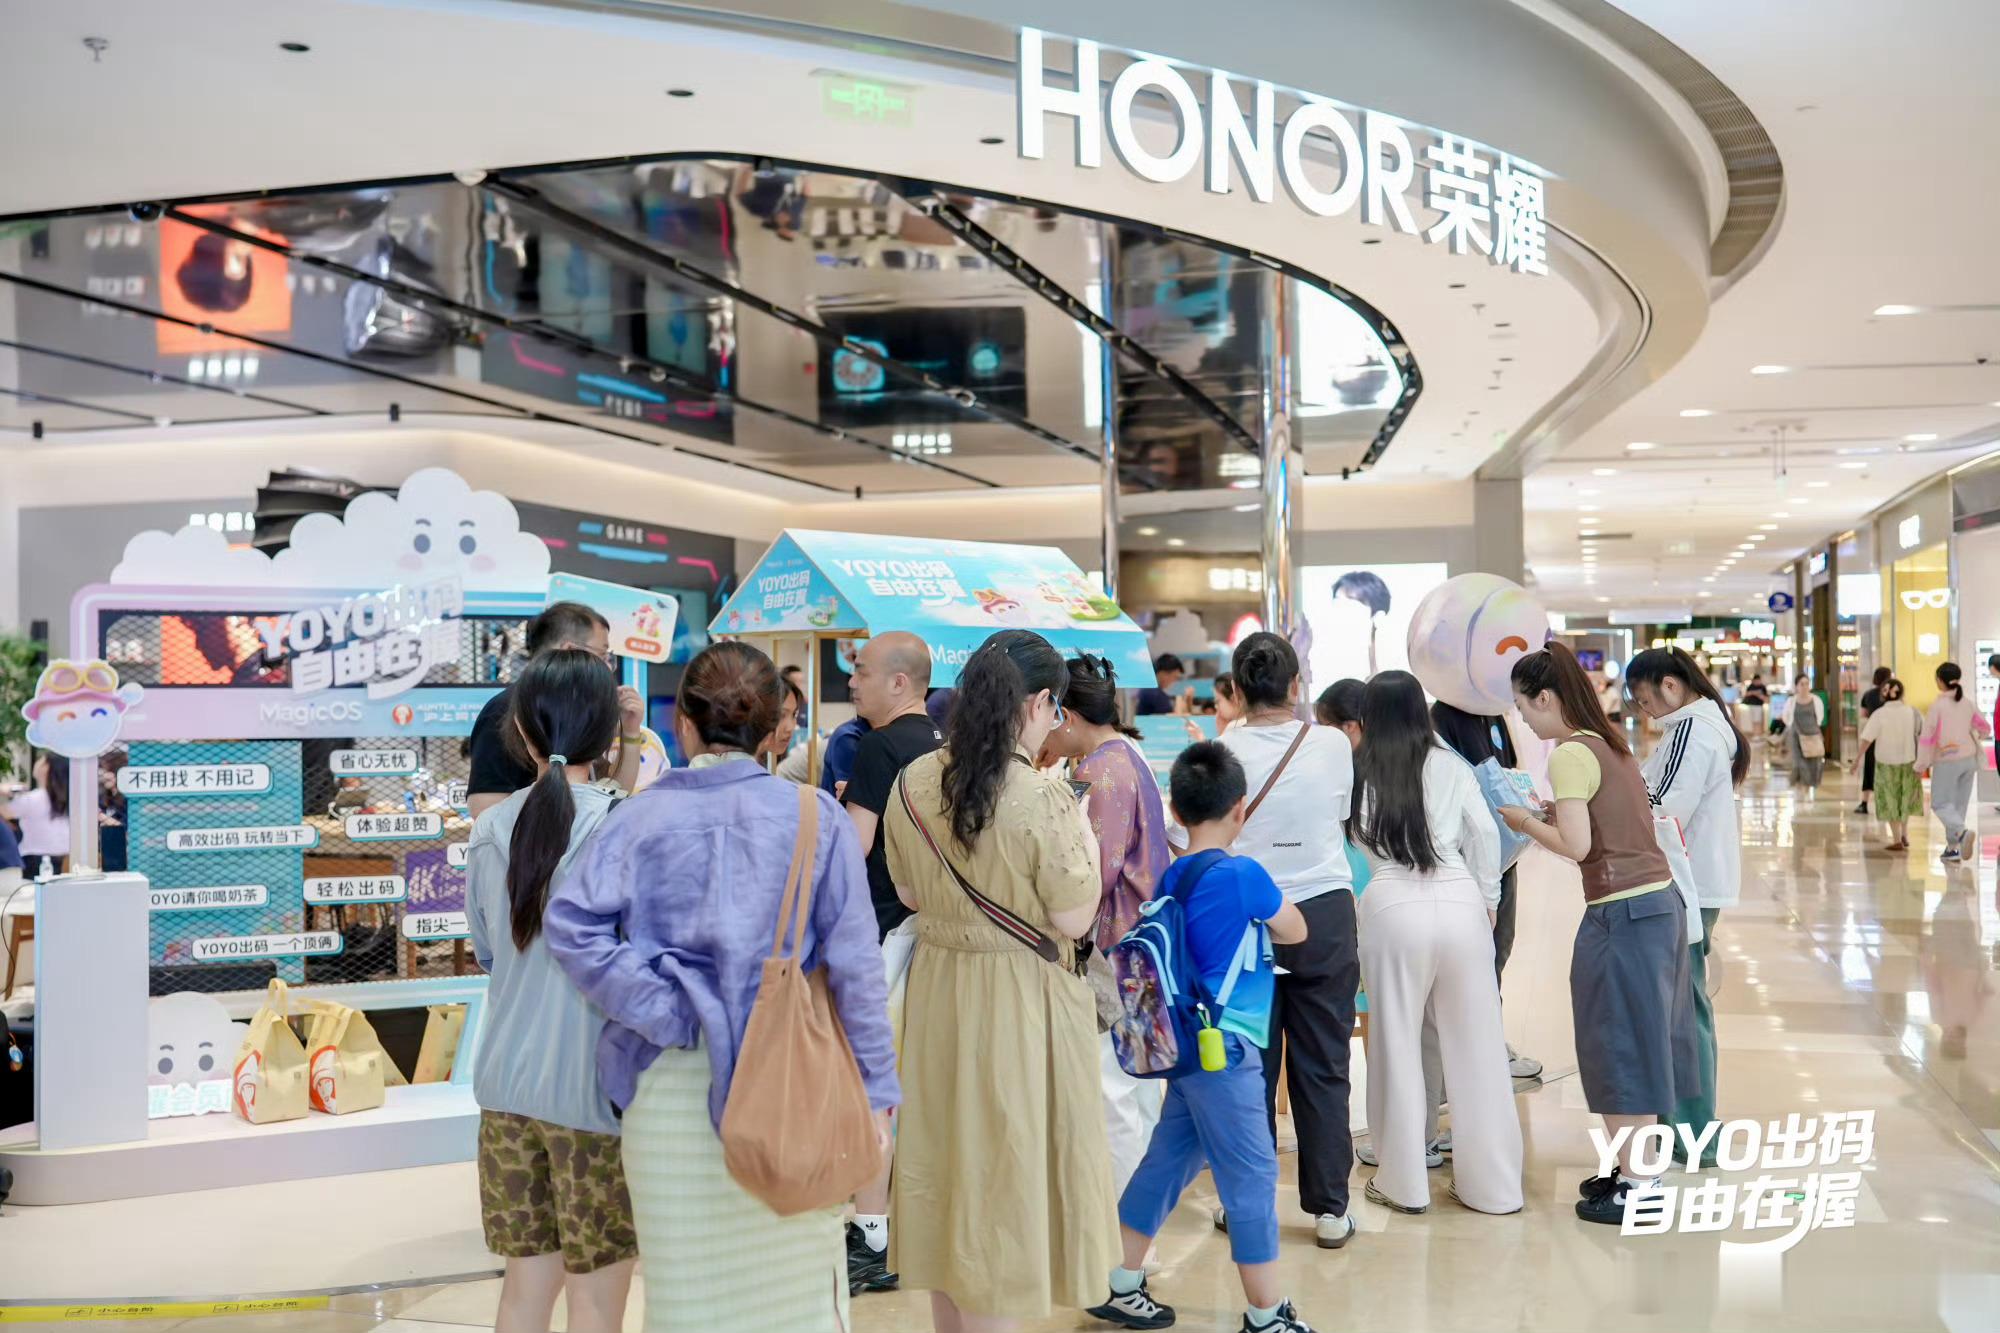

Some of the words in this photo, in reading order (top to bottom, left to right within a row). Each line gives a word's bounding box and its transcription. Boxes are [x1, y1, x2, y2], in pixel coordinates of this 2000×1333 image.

[1018, 26, 1420, 236] HONOR
[1422, 130, 1549, 277] 荣耀
[831, 559, 956, 578] YOYO出码
[757, 569, 811, 593] YOYO出码
[254, 576, 464, 660] YOYO出码
[927, 643, 972, 665] Mag
[259, 701, 363, 727] MagicOS
[340, 753, 408, 769] 省心无忧
[128, 770, 189, 789] 不用找
[195, 768, 255, 787] 不用记
[357, 817, 429, 834] 体验超赞
[178, 831, 240, 848] 高效出码
[244, 829, 305, 845] 玩转当下
[317, 880, 395, 897] 轻松出码
[416, 916, 470, 934] 指尖一
[200, 939, 269, 955] YOYO出码
[273, 935, 333, 951] 一个顶俩
